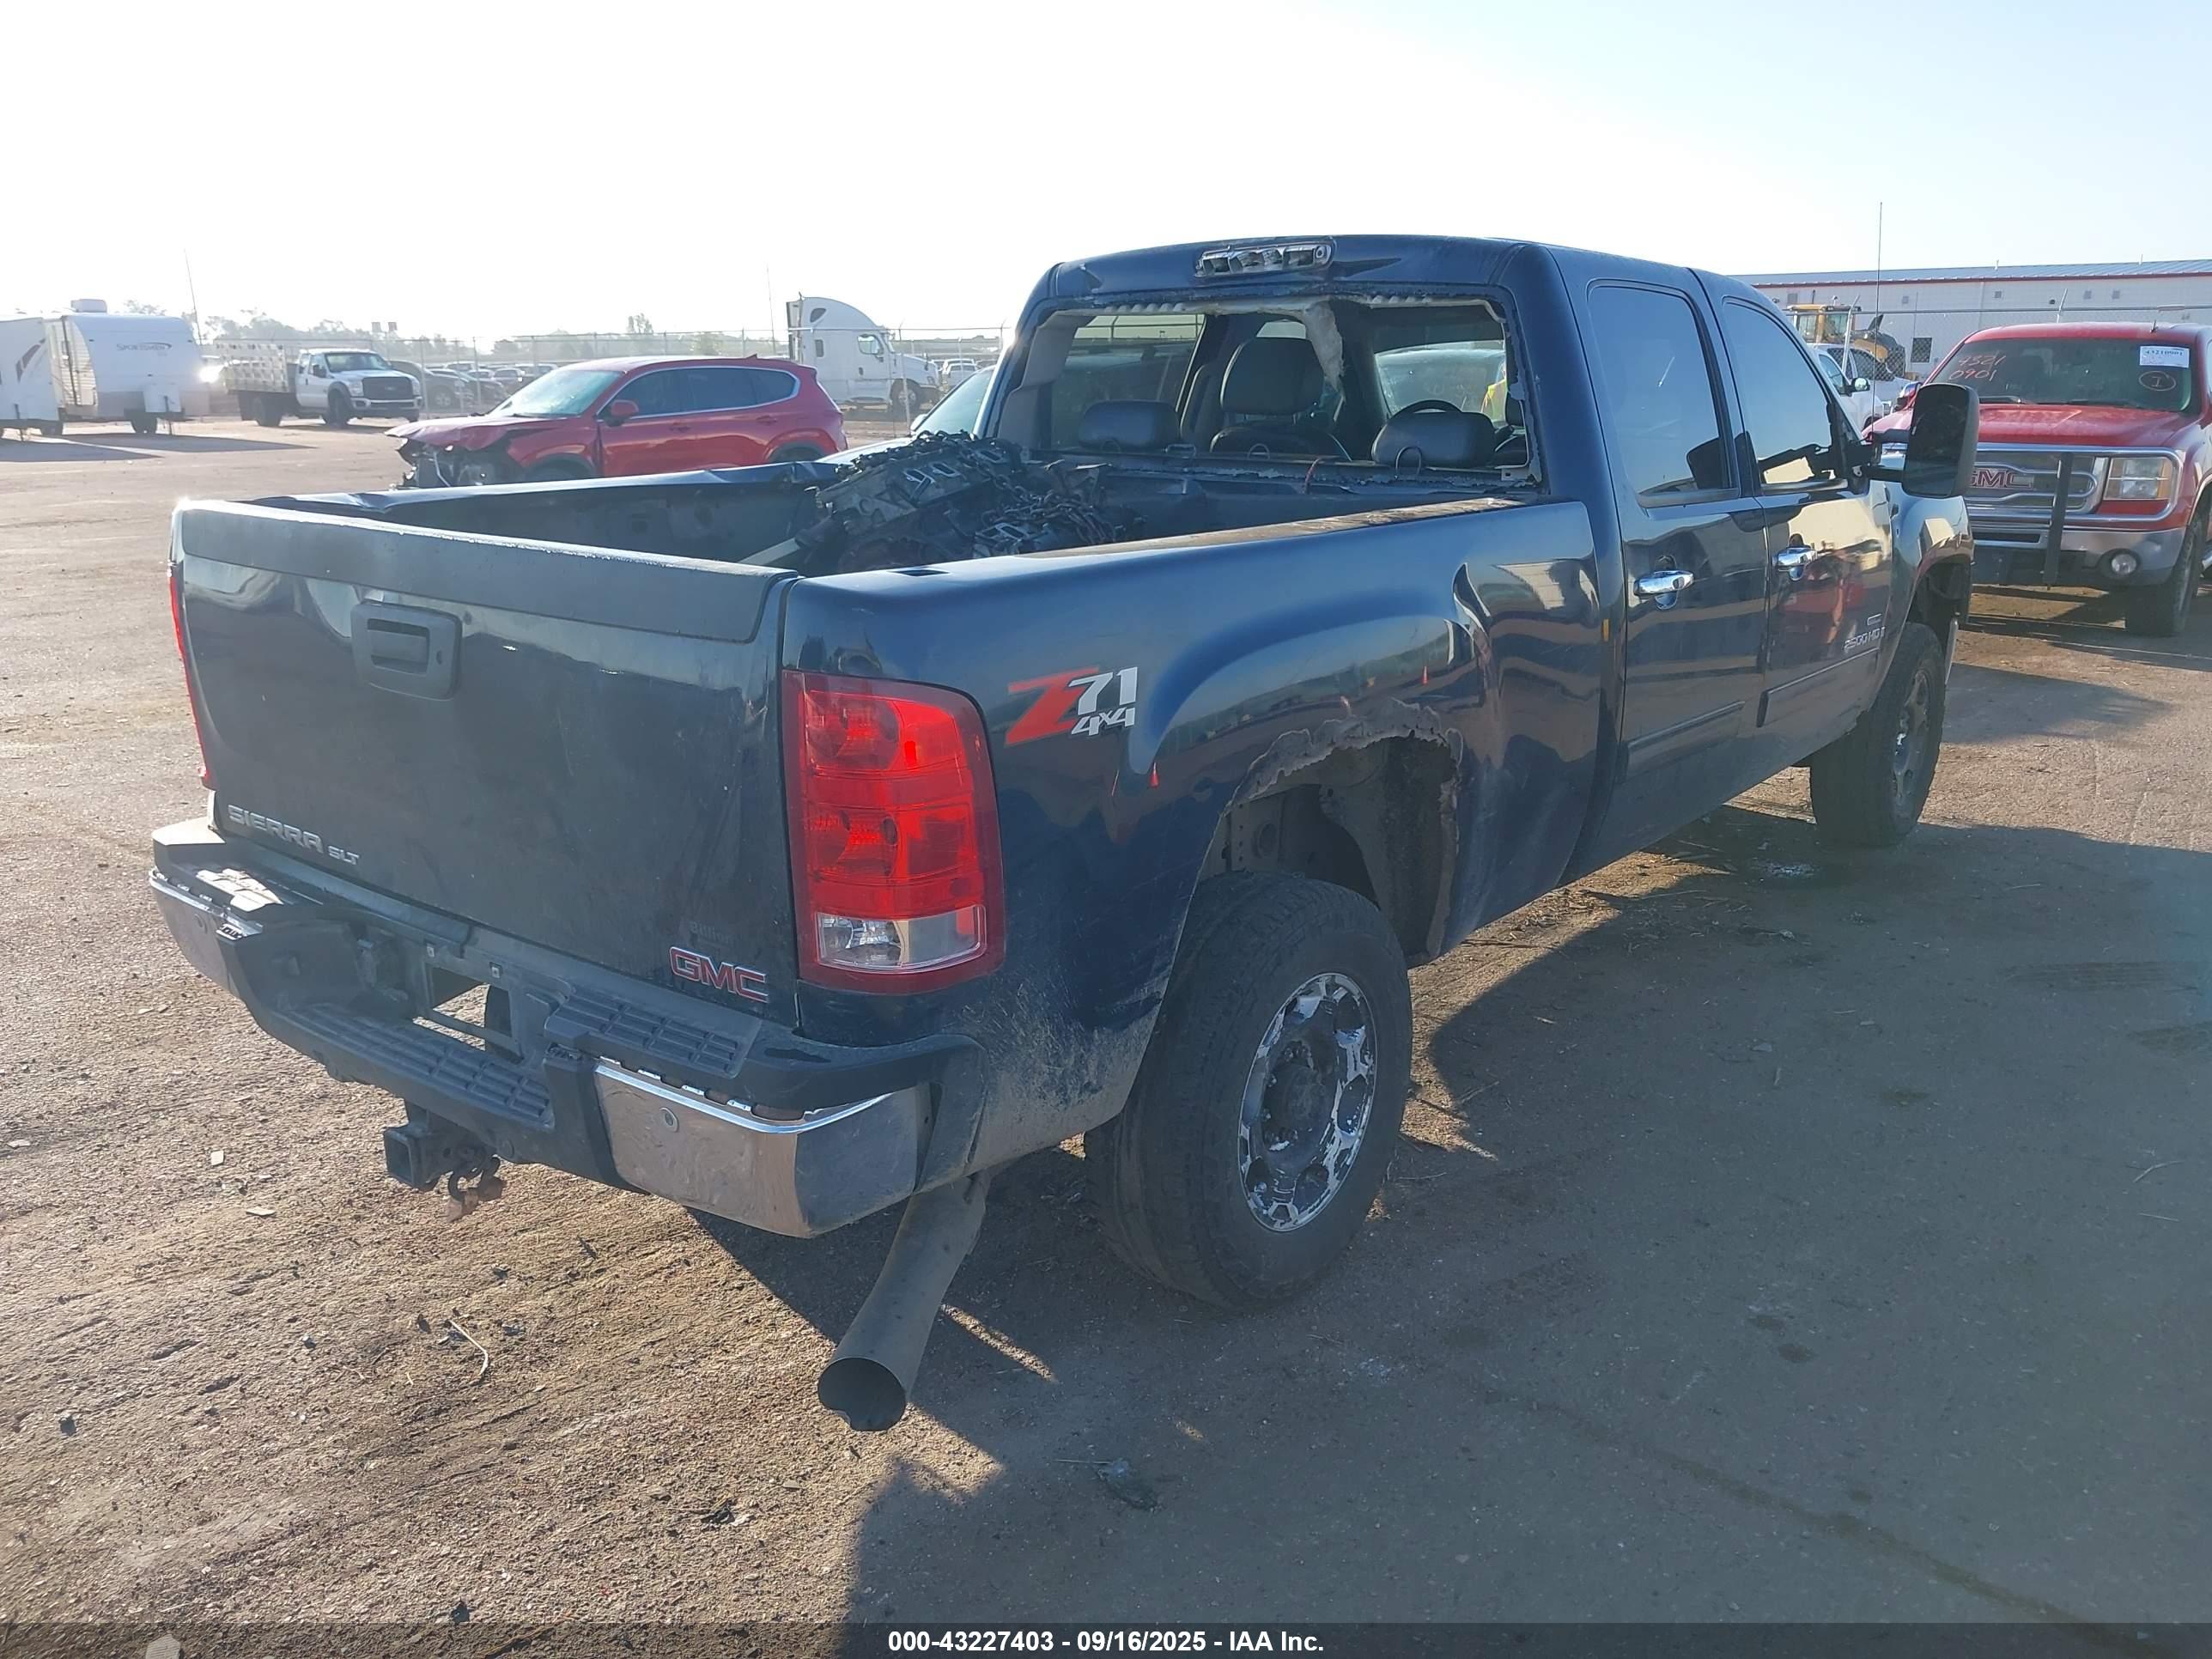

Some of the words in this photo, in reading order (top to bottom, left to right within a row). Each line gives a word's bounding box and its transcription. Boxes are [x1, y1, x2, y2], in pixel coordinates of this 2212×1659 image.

[1948, 368, 1998, 381] 0901
[228, 805, 324, 854] SIERRA
[328, 845, 360, 865] SLT
[670, 946, 769, 1003] GMC
